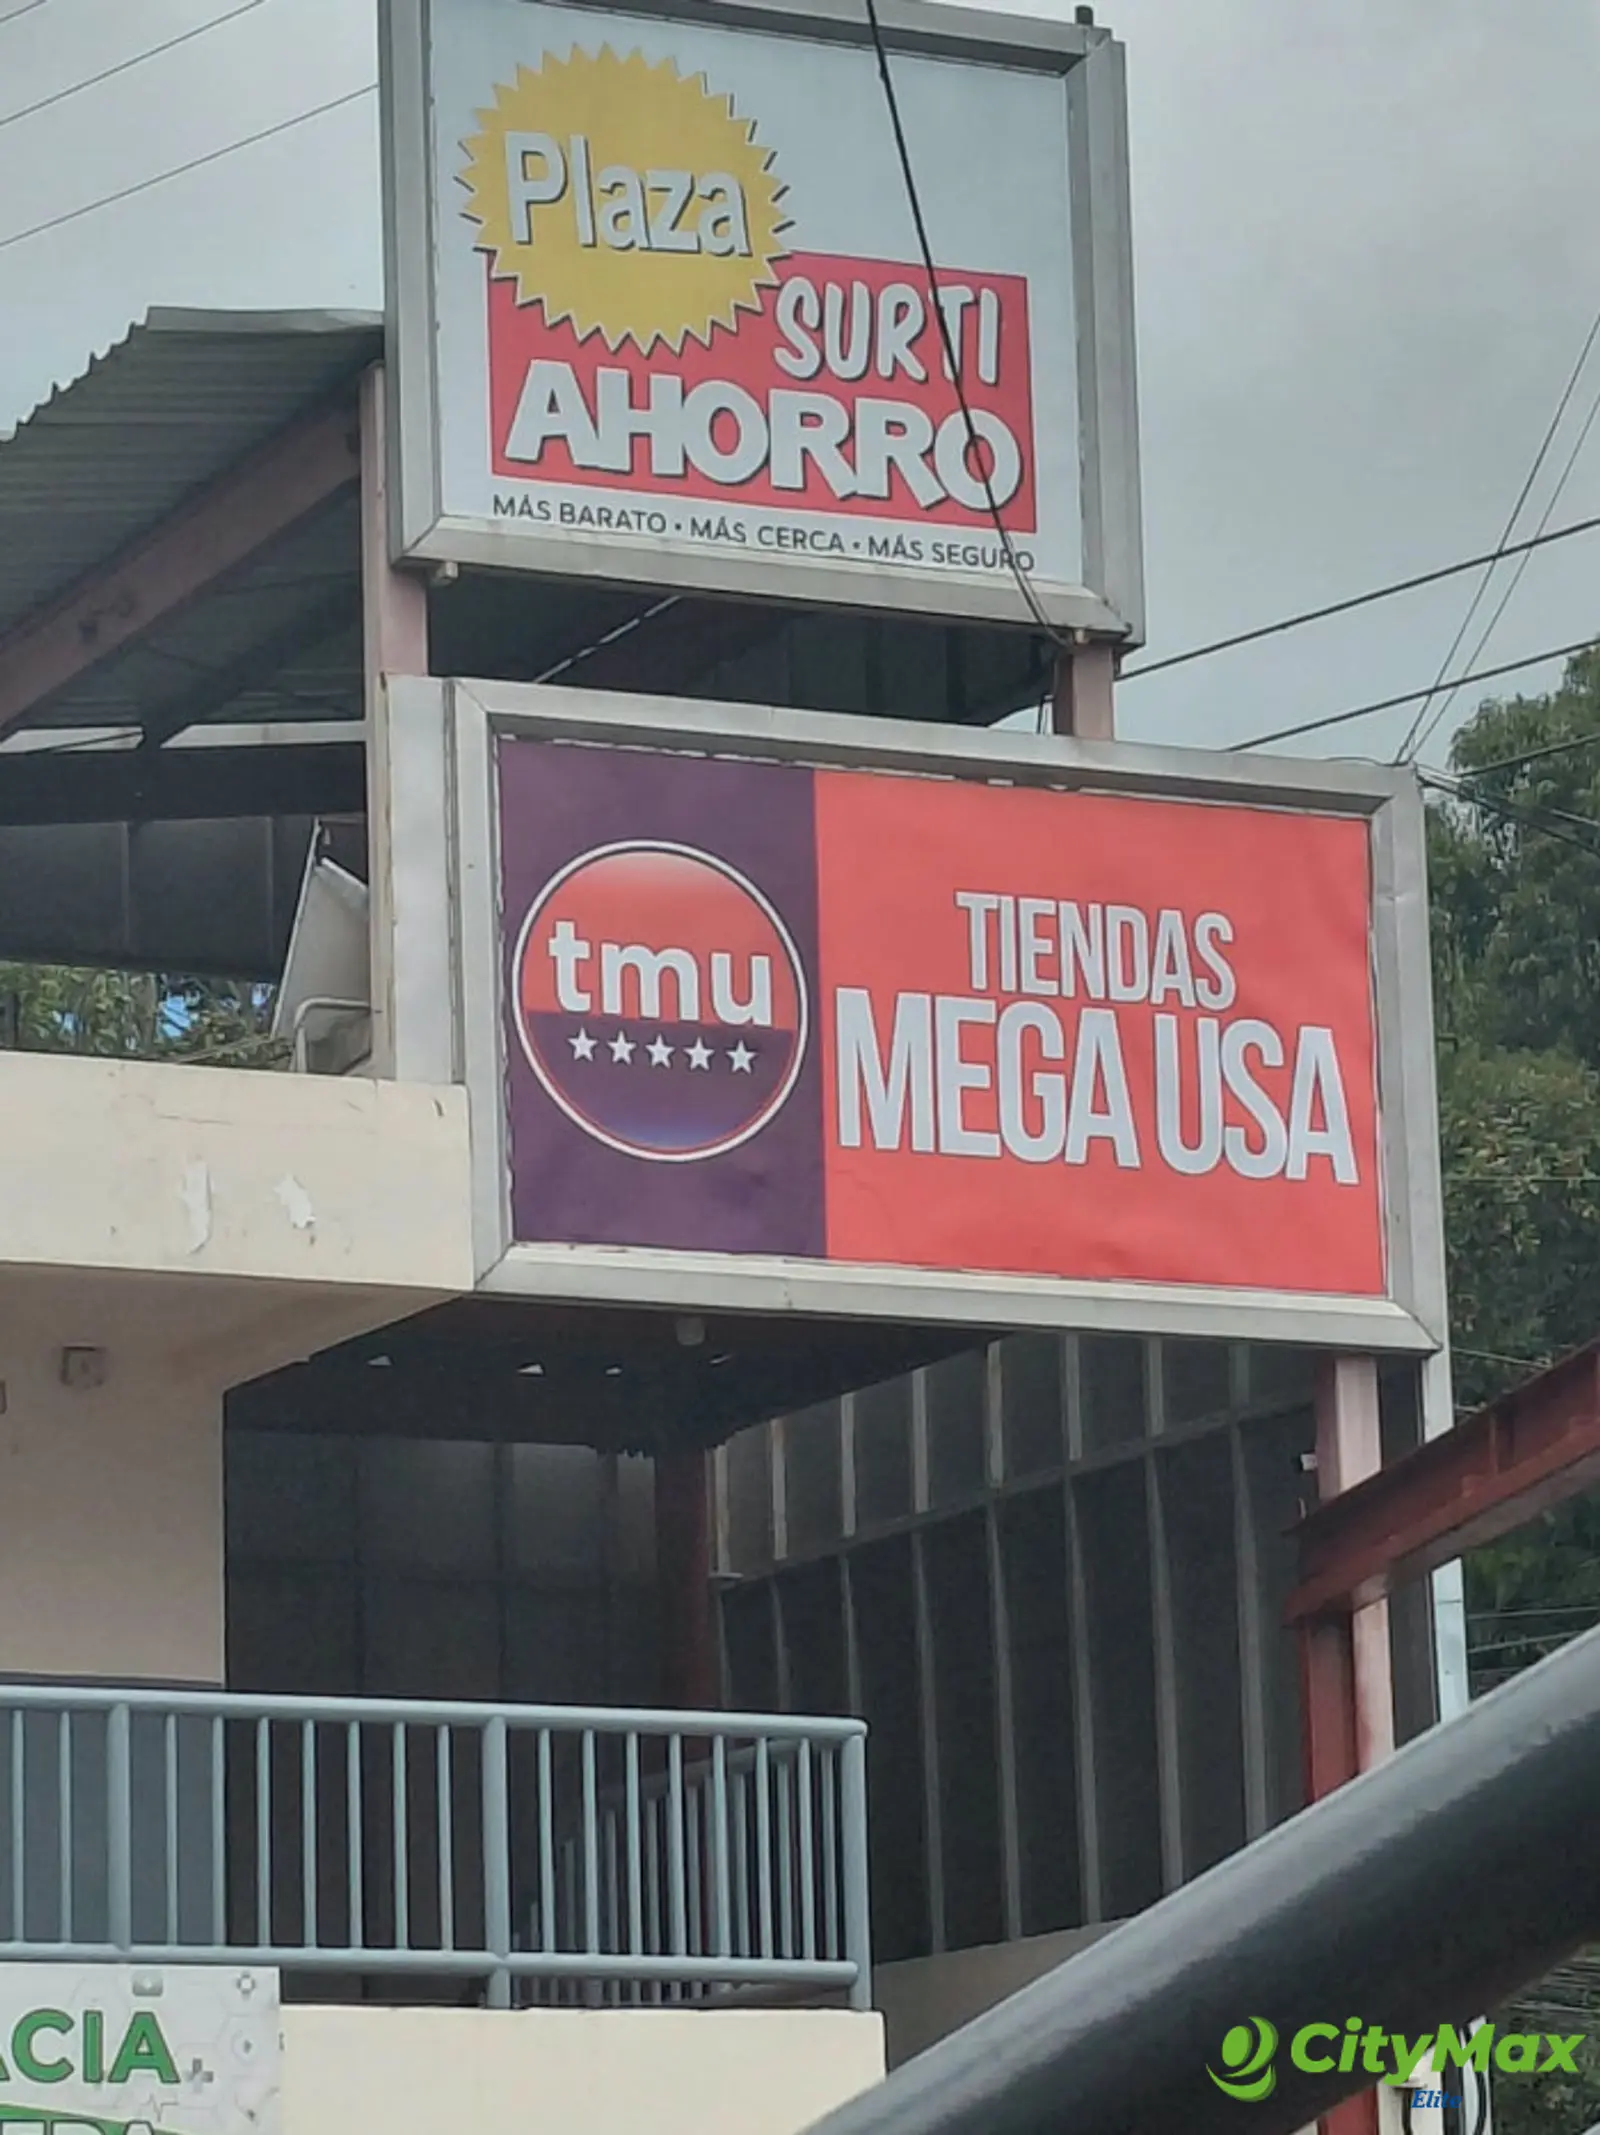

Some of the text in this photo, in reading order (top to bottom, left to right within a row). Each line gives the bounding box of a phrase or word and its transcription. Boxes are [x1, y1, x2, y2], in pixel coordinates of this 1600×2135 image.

[505, 130, 752, 257] Plaza
[772, 276, 999, 385] SURTI
[504, 359, 1023, 511] AHORRO
[493, 494, 551, 521] MÁS
[559, 502, 667, 533] BARATO
[690, 516, 747, 543] MÁS
[757, 525, 845, 552] CERCA
[867, 534, 924, 561] MÁS
[548, 920, 772, 1027] tmu
[955, 890, 1235, 1010] TIENDAS
[835, 987, 1360, 1187] MEGA USA
[0, 2008, 181, 2084] CIA
